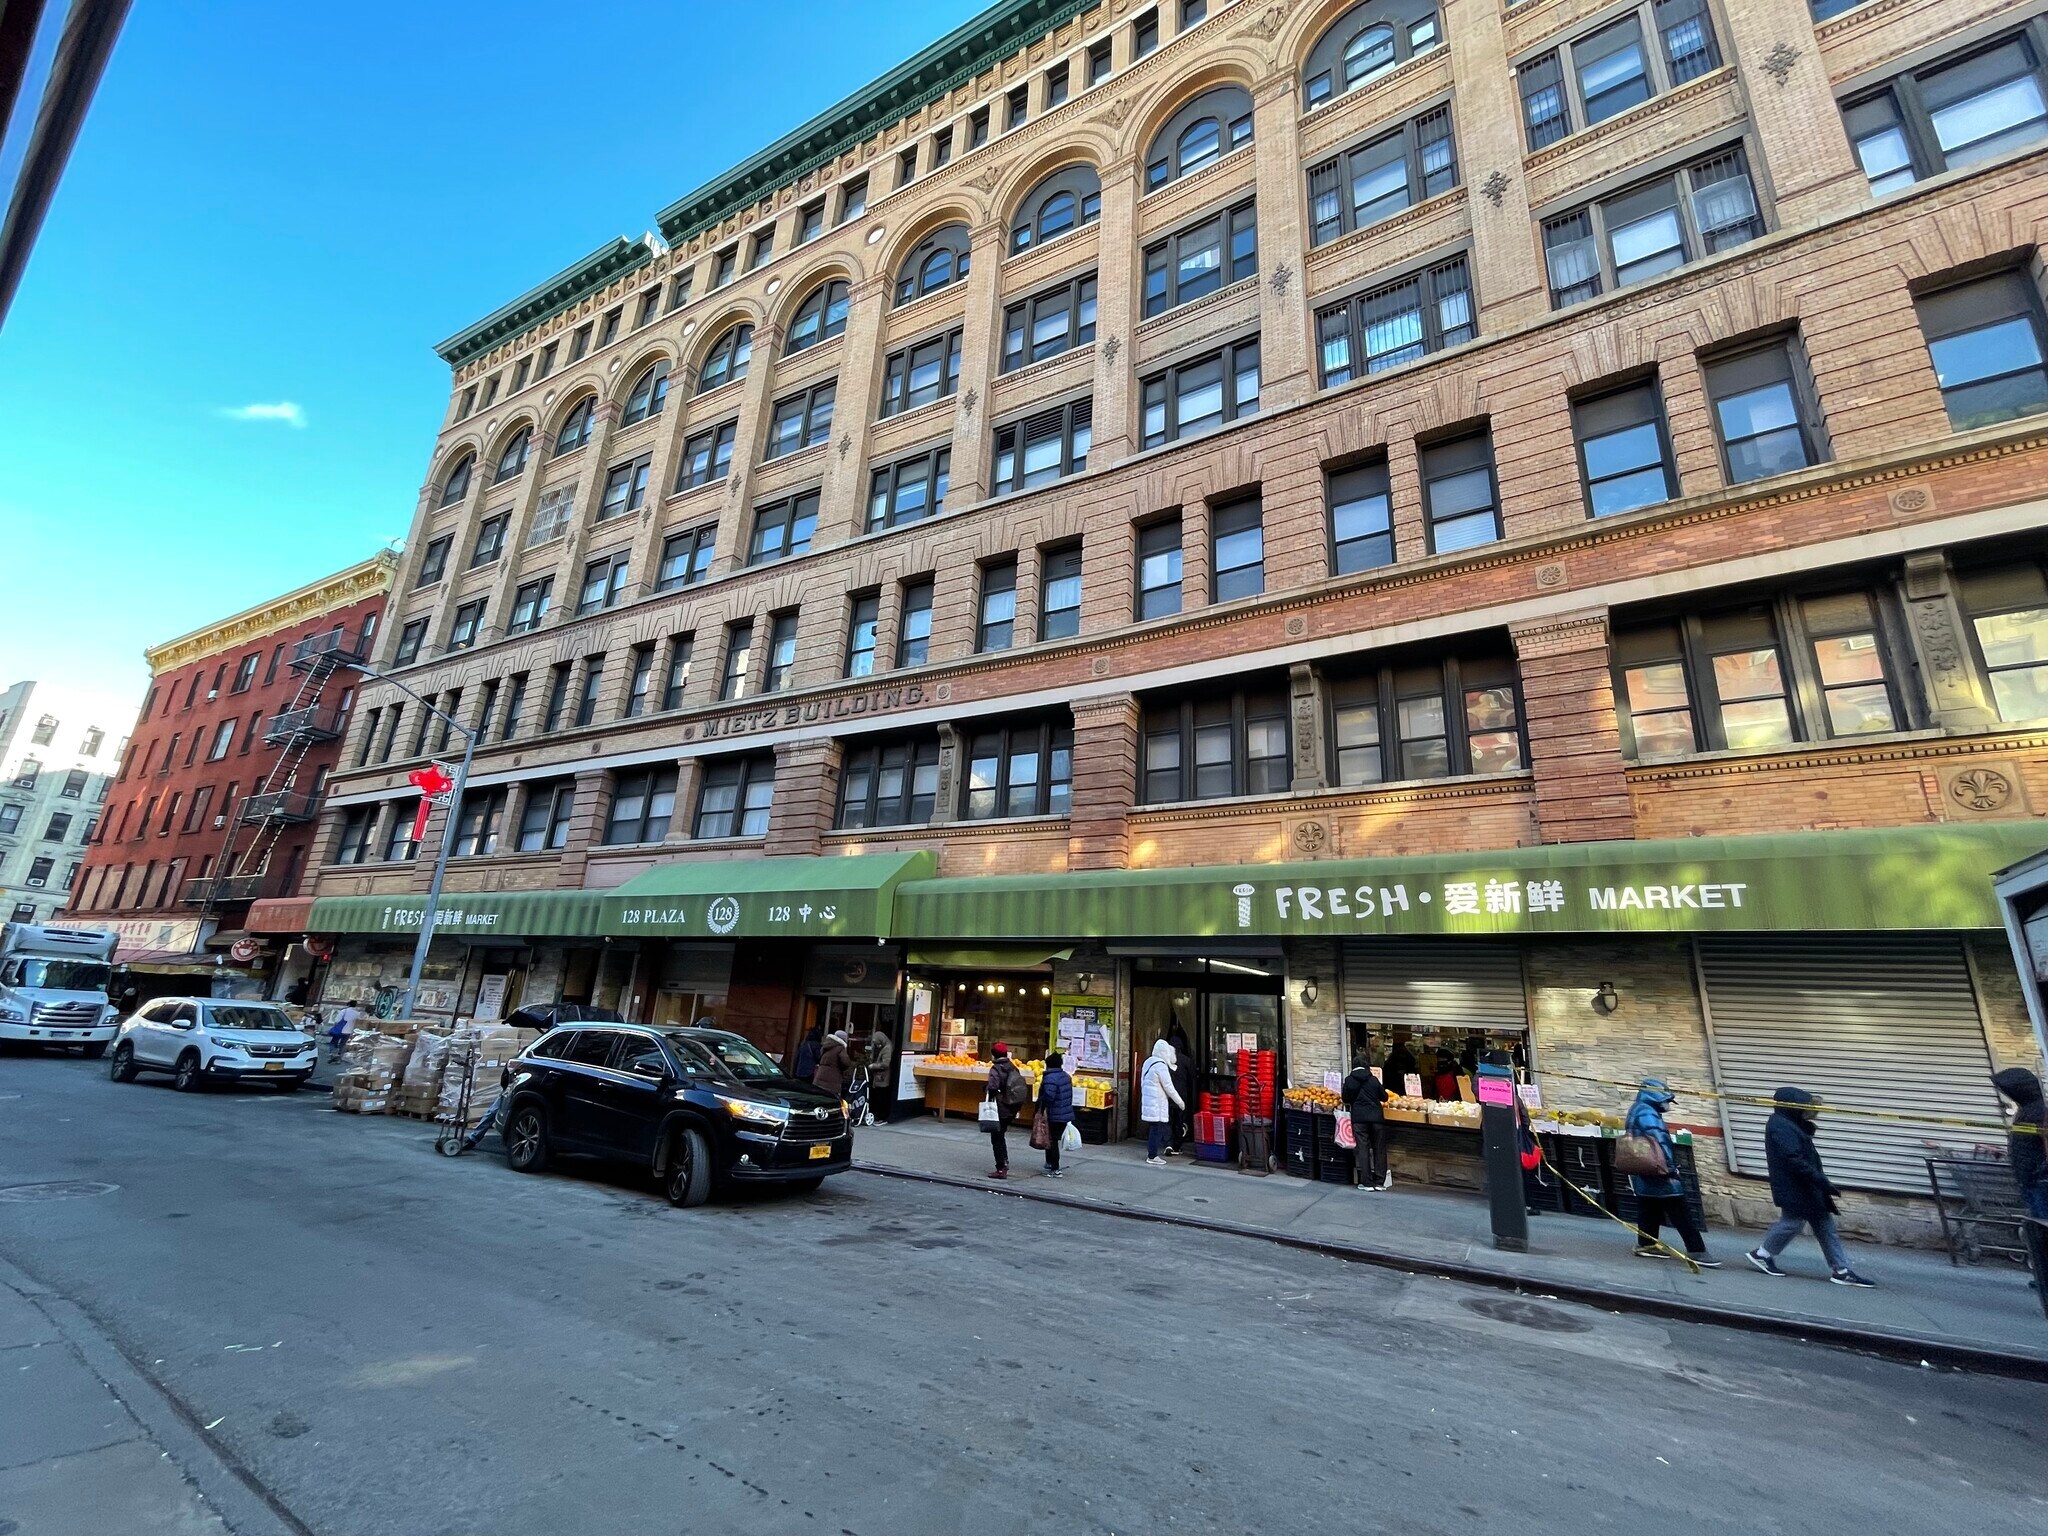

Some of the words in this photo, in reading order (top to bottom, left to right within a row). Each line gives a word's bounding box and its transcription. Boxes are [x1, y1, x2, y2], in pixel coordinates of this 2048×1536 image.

[702, 709, 777, 737] MIETZ
[1275, 884, 1409, 921] FRESH
[1444, 878, 1565, 915] 爱新鲜
[1589, 883, 1747, 910] MARKET
[465, 914, 498, 925] MARKET
[621, 909, 640, 924] 128
[643, 909, 686, 924] PLAZA
[714, 907, 733, 921] 128
[768, 906, 791, 922] 128
[798, 903, 837, 923] 中心
